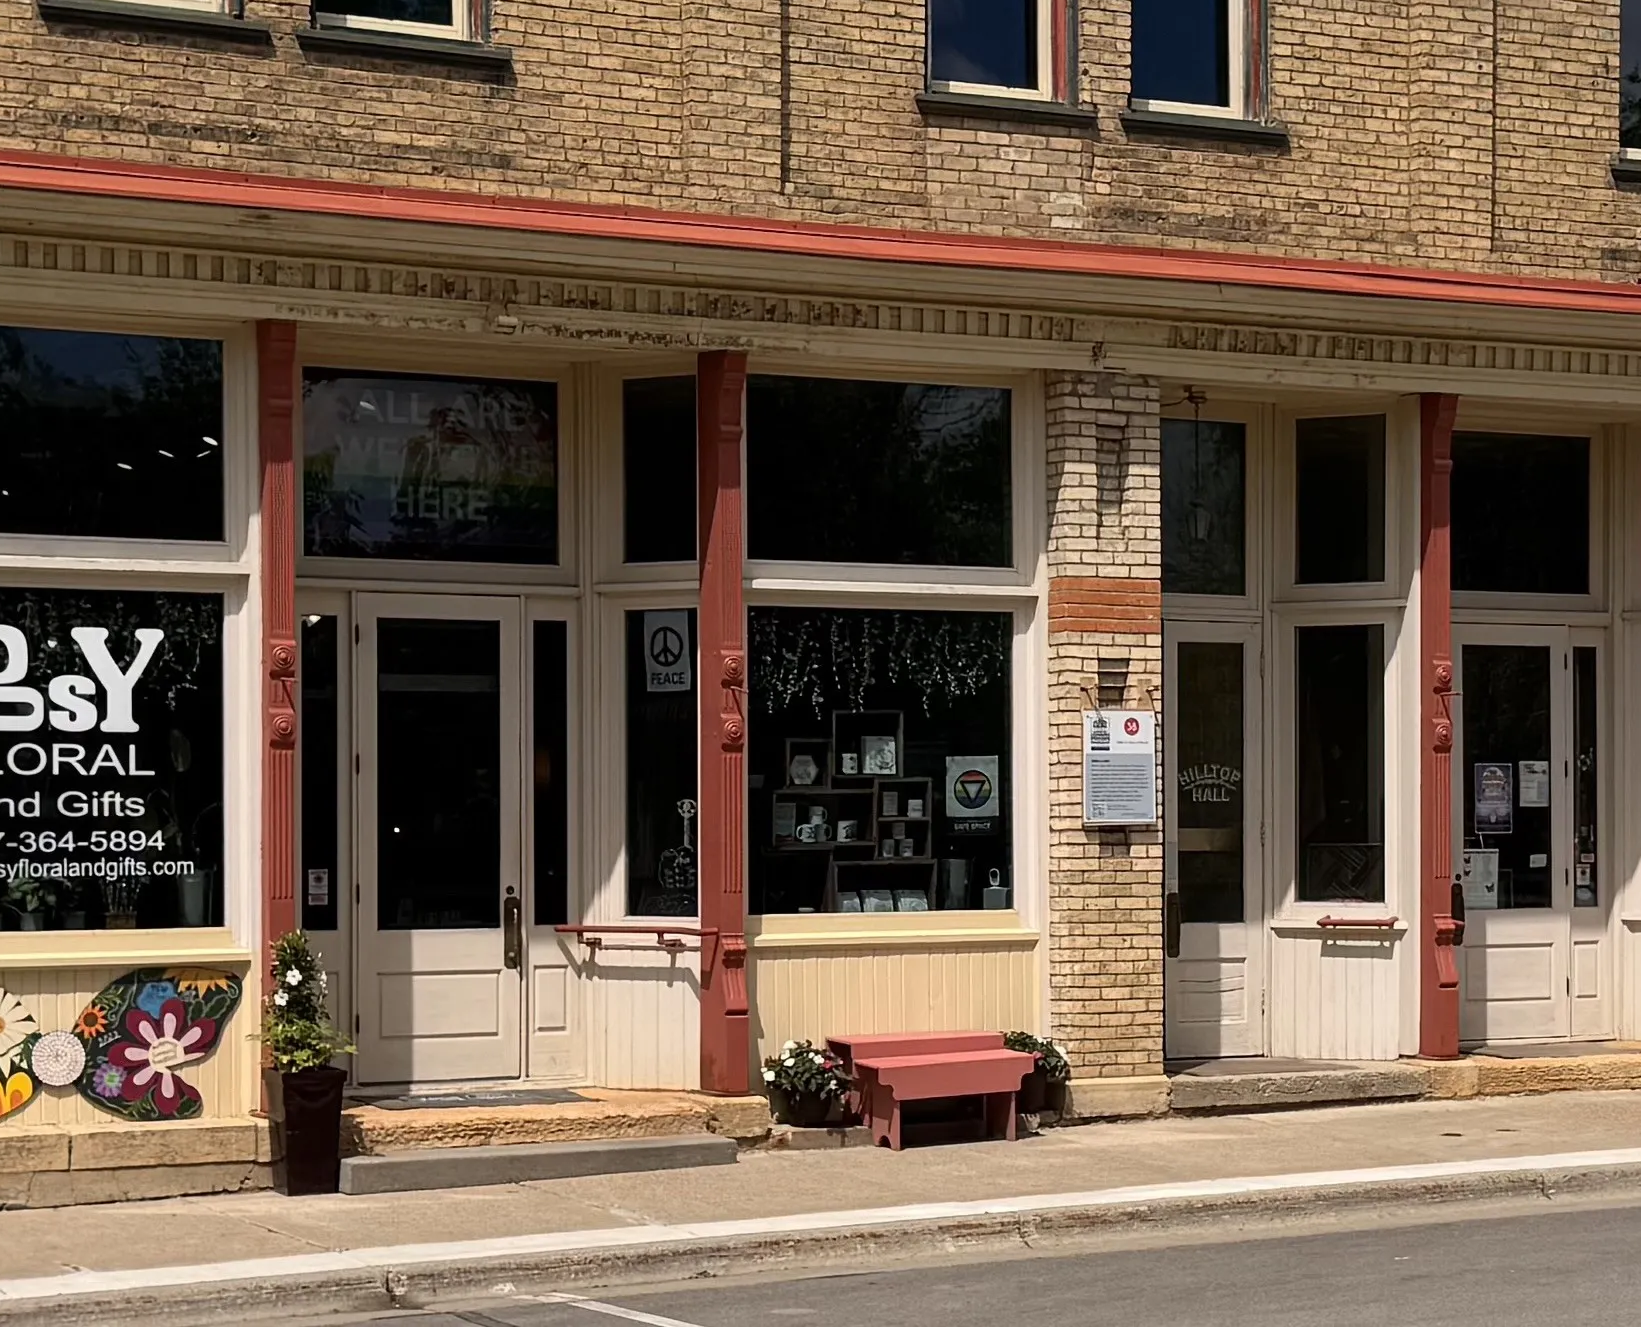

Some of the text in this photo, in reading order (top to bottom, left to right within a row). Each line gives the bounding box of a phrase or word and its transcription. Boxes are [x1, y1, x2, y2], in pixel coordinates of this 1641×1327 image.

[355, 389, 528, 432] ALL ARE
[390, 484, 490, 522] HERE
[651, 672, 686, 685] PEACE
[1177, 763, 1241, 785] HILLTOP
[56, 790, 146, 817] Gifts
[1192, 787, 1230, 802] HALL
